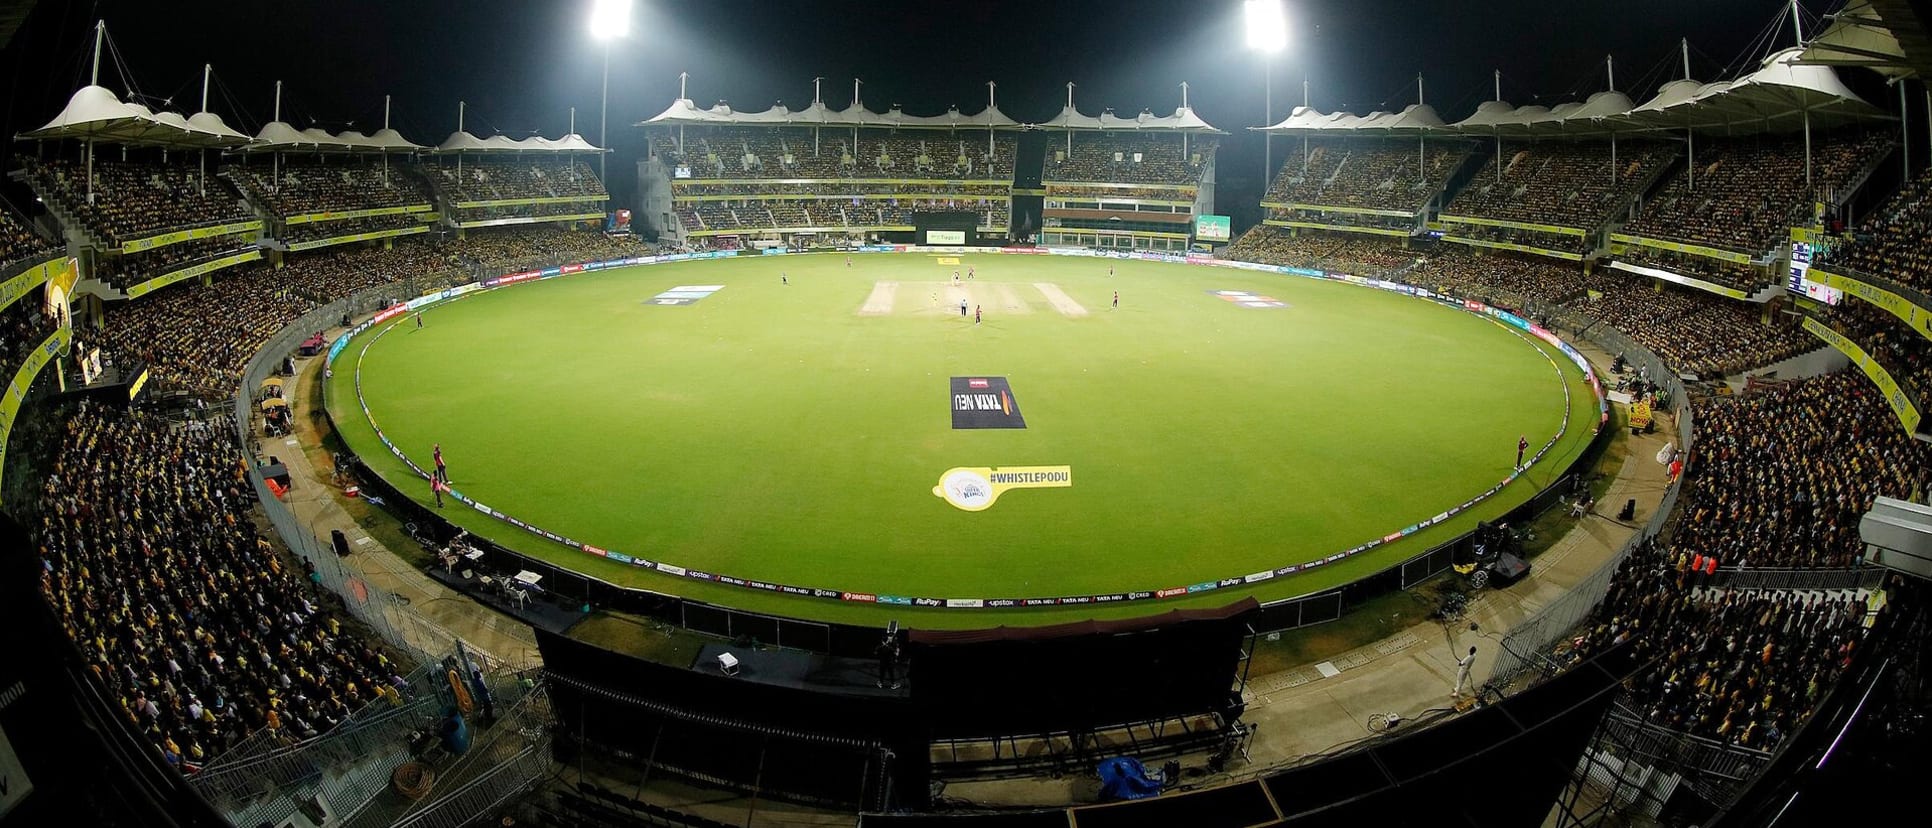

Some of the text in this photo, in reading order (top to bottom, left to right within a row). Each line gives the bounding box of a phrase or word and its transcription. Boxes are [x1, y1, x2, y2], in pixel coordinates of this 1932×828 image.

[954, 394, 1002, 411] TATA NEU
[990, 471, 1068, 483] #WHISTLEPODU
[689, 571, 710, 579] upstox
[916, 598, 938, 607] RuPay
[989, 599, 1014, 607] upstox
